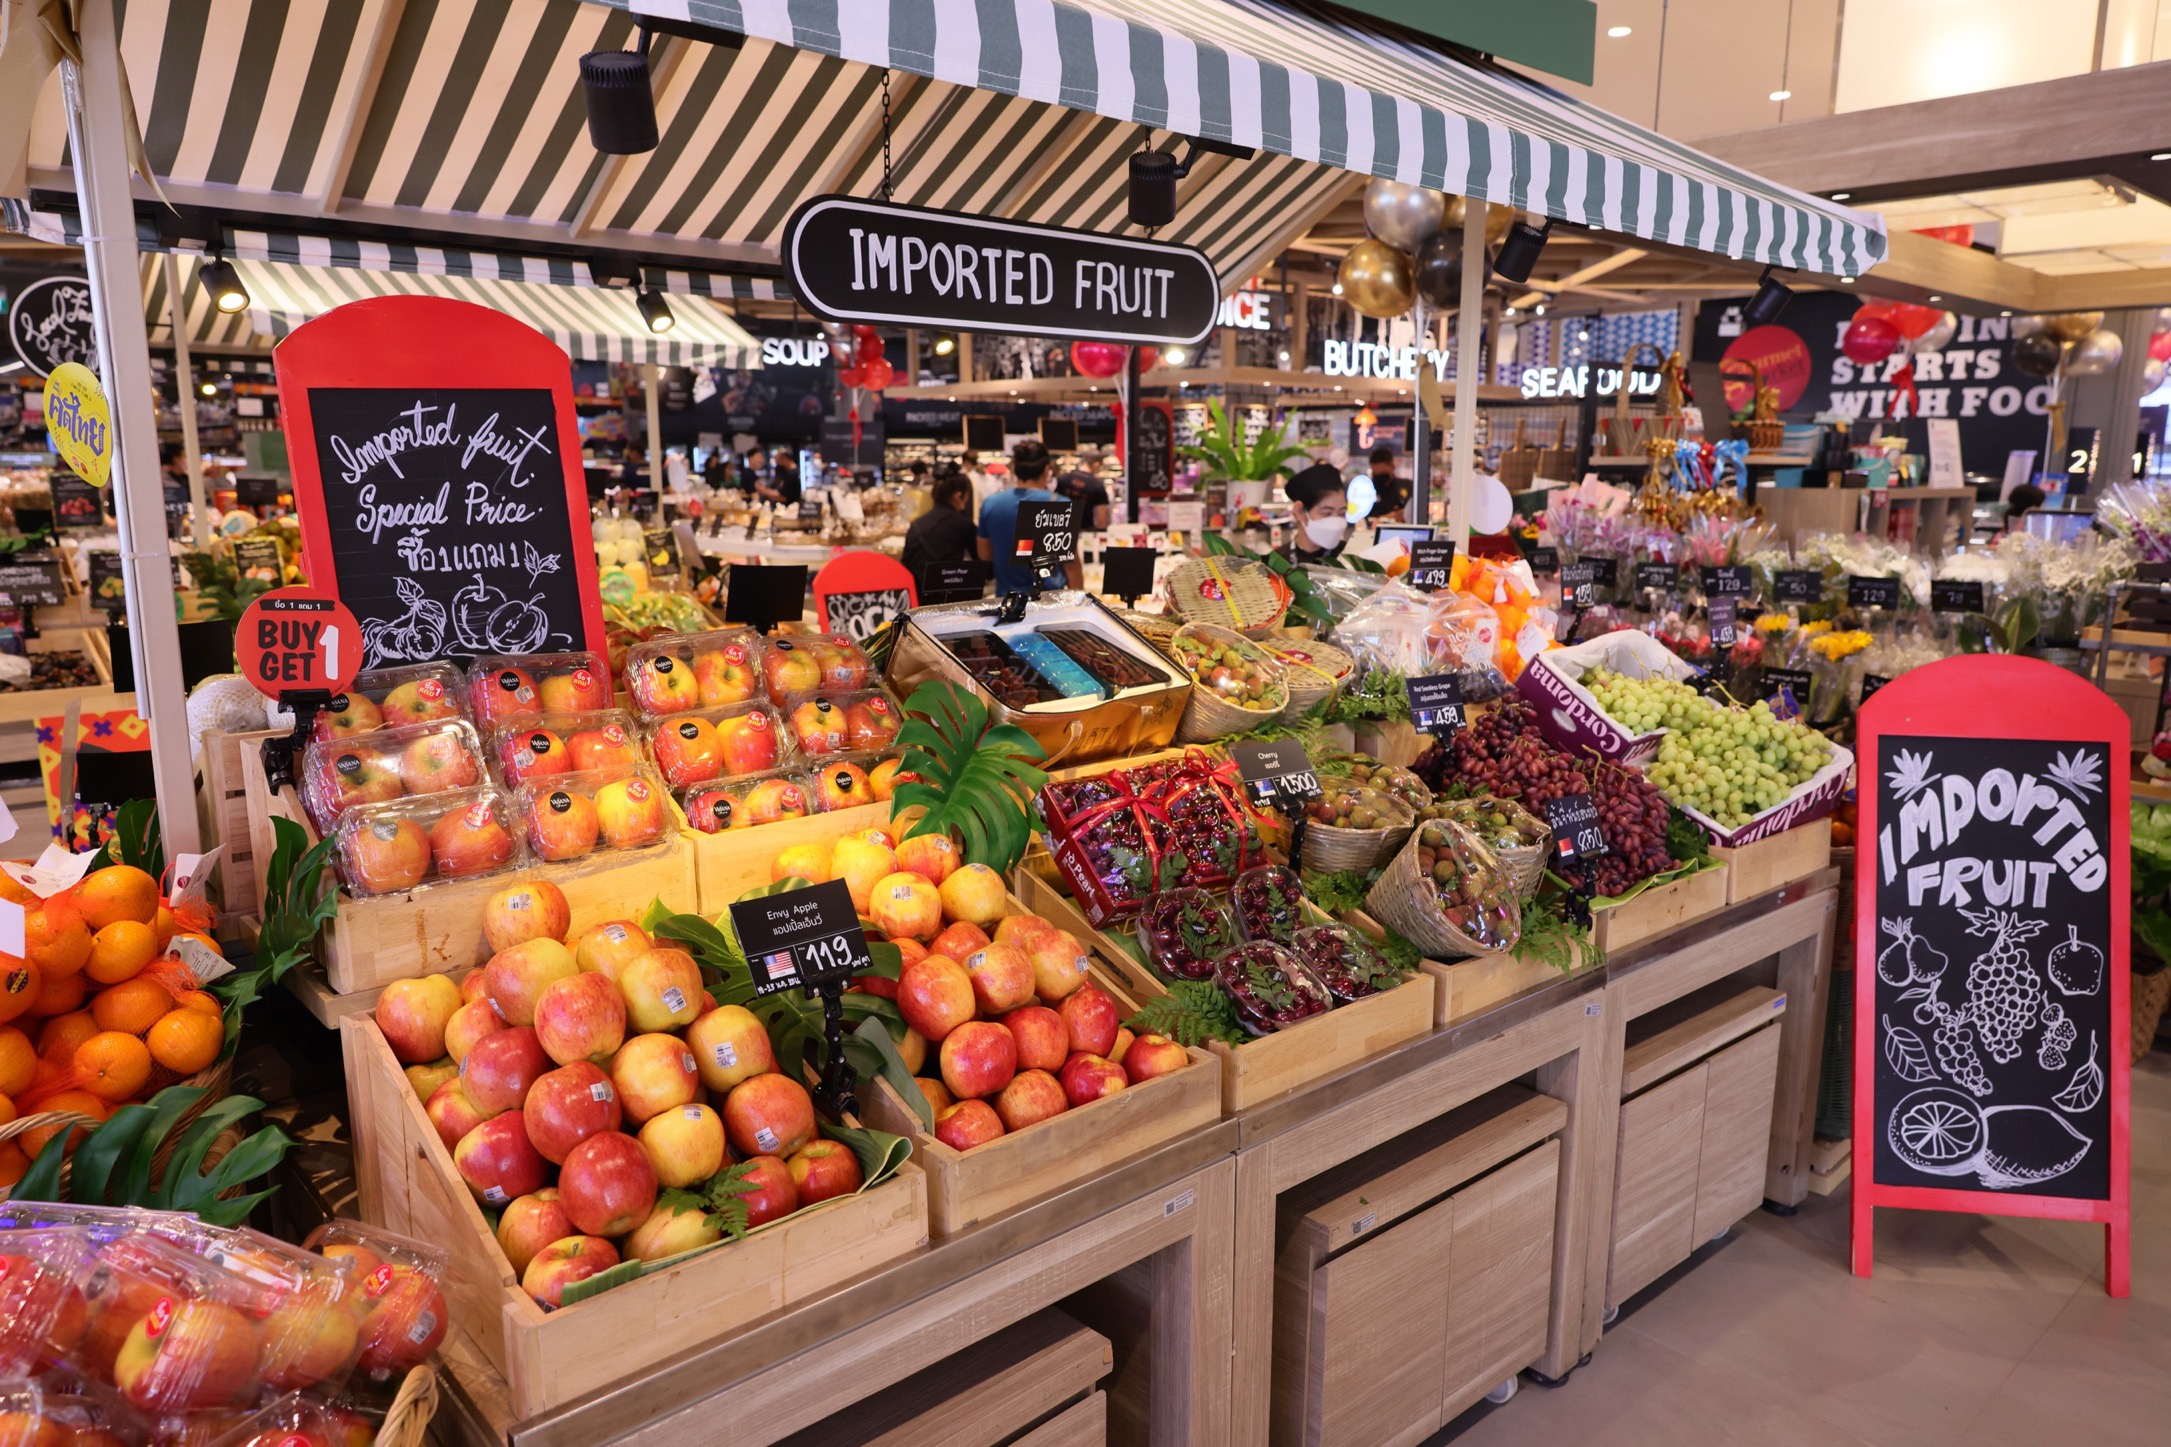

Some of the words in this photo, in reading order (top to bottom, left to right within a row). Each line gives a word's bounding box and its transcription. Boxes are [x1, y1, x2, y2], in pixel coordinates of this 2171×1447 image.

[849, 228, 1053, 305] IMPORTED
[1075, 259, 1175, 318] FRUIT
[762, 337, 830, 367] SOUP
[1324, 339, 1450, 383] BUTCHEY
[1830, 348, 2001, 386] STARTS
[1959, 385, 2052, 418] FOO
[330, 400, 461, 484] Imported
[2068, 449, 2088, 473] 2
[2132, 452, 2142, 474] 1
[356, 481, 450, 545] Special
[1043, 532, 1072, 552] 850
[1425, 569, 1445, 586] 499
[1718, 578, 1741, 591] 129
[1789, 582, 1807, 595] 50
[274, 600, 286, 609] ซื้อ
[1862, 589, 1886, 602] 129
[258, 619, 321, 650] BUY
[319, 624, 339, 681] 1
[259, 651, 316, 682] GET
[435, 687, 441, 697] 1
[586, 677, 591, 685] 1
[1436, 706, 1458, 724] 459
[1530, 660, 1621, 753] Cordona
[617, 733, 622, 742] 1
[1257, 752, 1279, 760] Cherry
[642, 789, 648, 798] 1
[1073, 863, 1096, 898] Pearl
[1907, 857, 2057, 908] FRUIT
[766, 908, 790, 921] Envy
[793, 901, 819, 914] Apple
[805, 935, 853, 971] 119
